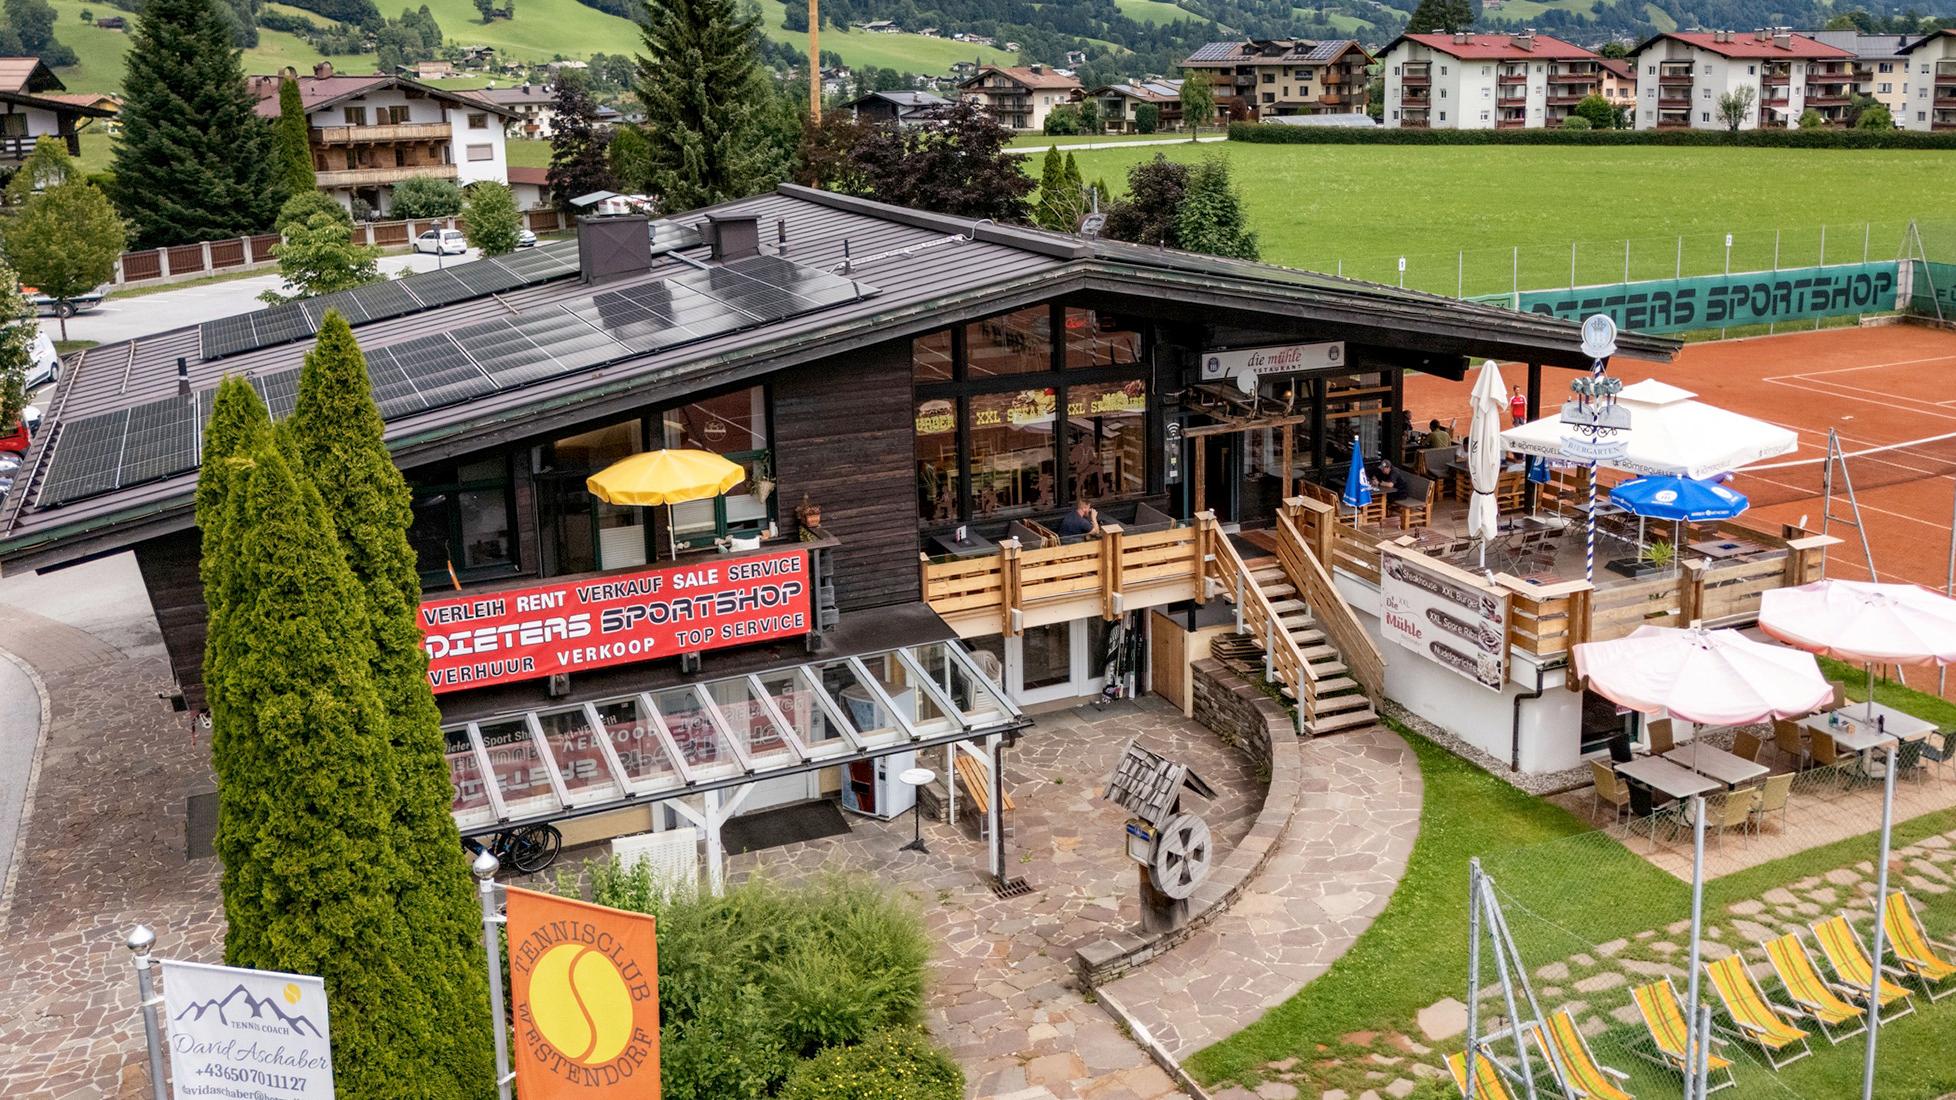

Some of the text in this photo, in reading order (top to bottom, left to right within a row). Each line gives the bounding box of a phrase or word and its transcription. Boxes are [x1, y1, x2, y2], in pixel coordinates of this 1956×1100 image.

[1706, 272, 1892, 321] SPORTSHOP
[1248, 347, 1302, 367] die mühle
[1253, 364, 1301, 373] STAURANT
[976, 410, 1001, 425] XXL
[1518, 440, 1561, 455] RÖMERQUELL
[1568, 442, 1619, 455] BIERGARTEN
[424, 557, 800, 625] VERLEIH RENT VERKAUF SALE SERVICE
[1402, 568, 1480, 608] Steakhouse XXL Burger
[1386, 596, 1399, 610] Die
[425, 581, 803, 659] DIETERS SPORTSHOP
[1385, 612, 1423, 639] Mühle
[429, 613, 804, 686] VERHUUR VERKOOP TOP SERVICE
[483, 733, 512, 748] Sport
[515, 920, 650, 1001] TENNISCLUB
[231, 1021, 289, 1036] TENNIS COACH
[172, 1032, 328, 1071] David Aschaber
[519, 1003, 652, 1088] WESTENDORF
